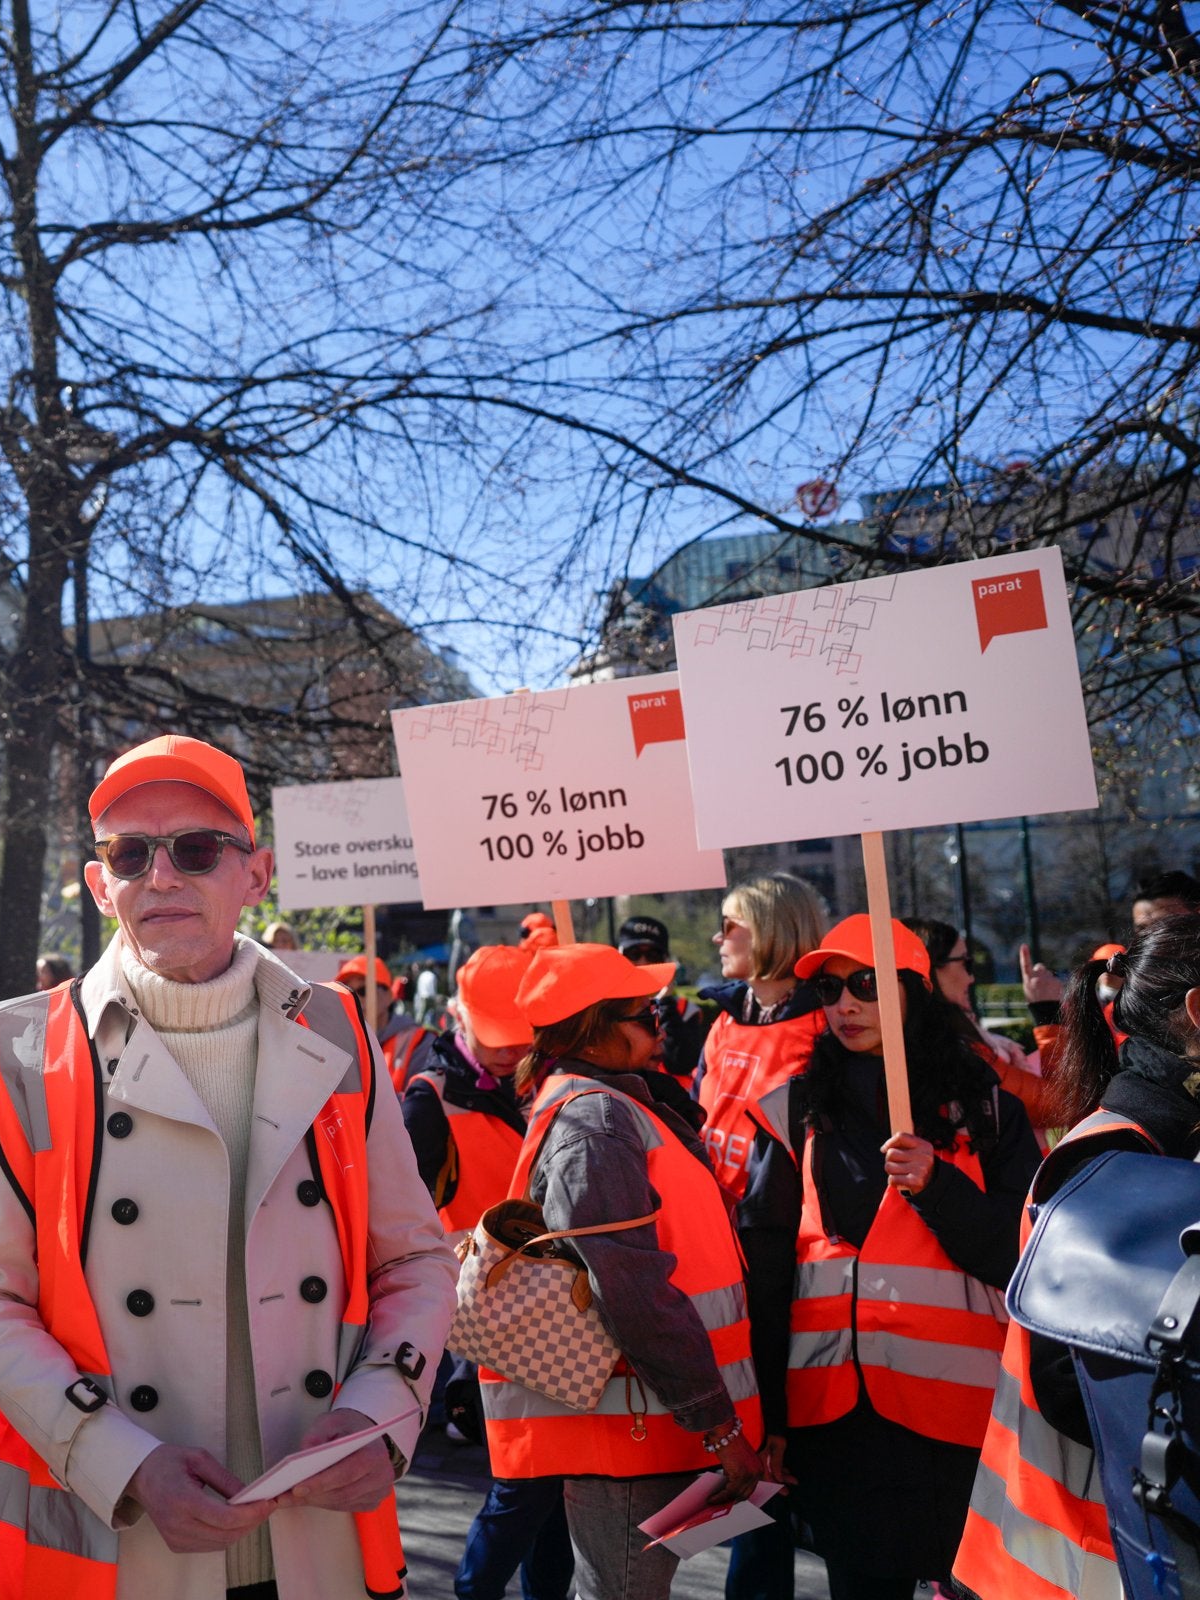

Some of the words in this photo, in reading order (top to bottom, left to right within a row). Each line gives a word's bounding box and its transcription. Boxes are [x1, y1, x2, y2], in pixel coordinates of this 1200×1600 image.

[978, 578, 1022, 598] parat
[632, 695, 667, 711] parat
[780, 702, 826, 736] 76
[838, 696, 869, 729] %
[881, 690, 968, 722] lønn
[775, 750, 845, 786] 100
[856, 744, 888, 777] %
[898, 732, 990, 782] jobb
[482, 793, 518, 820] 76
[527, 789, 551, 816] %
[560, 787, 627, 813] lønn
[294, 841, 341, 858] Store
[346, 834, 413, 854] oversku
[480, 834, 534, 861] 100
[543, 830, 568, 856] %
[575, 823, 645, 861] jobb
[312, 865, 348, 881] lave
